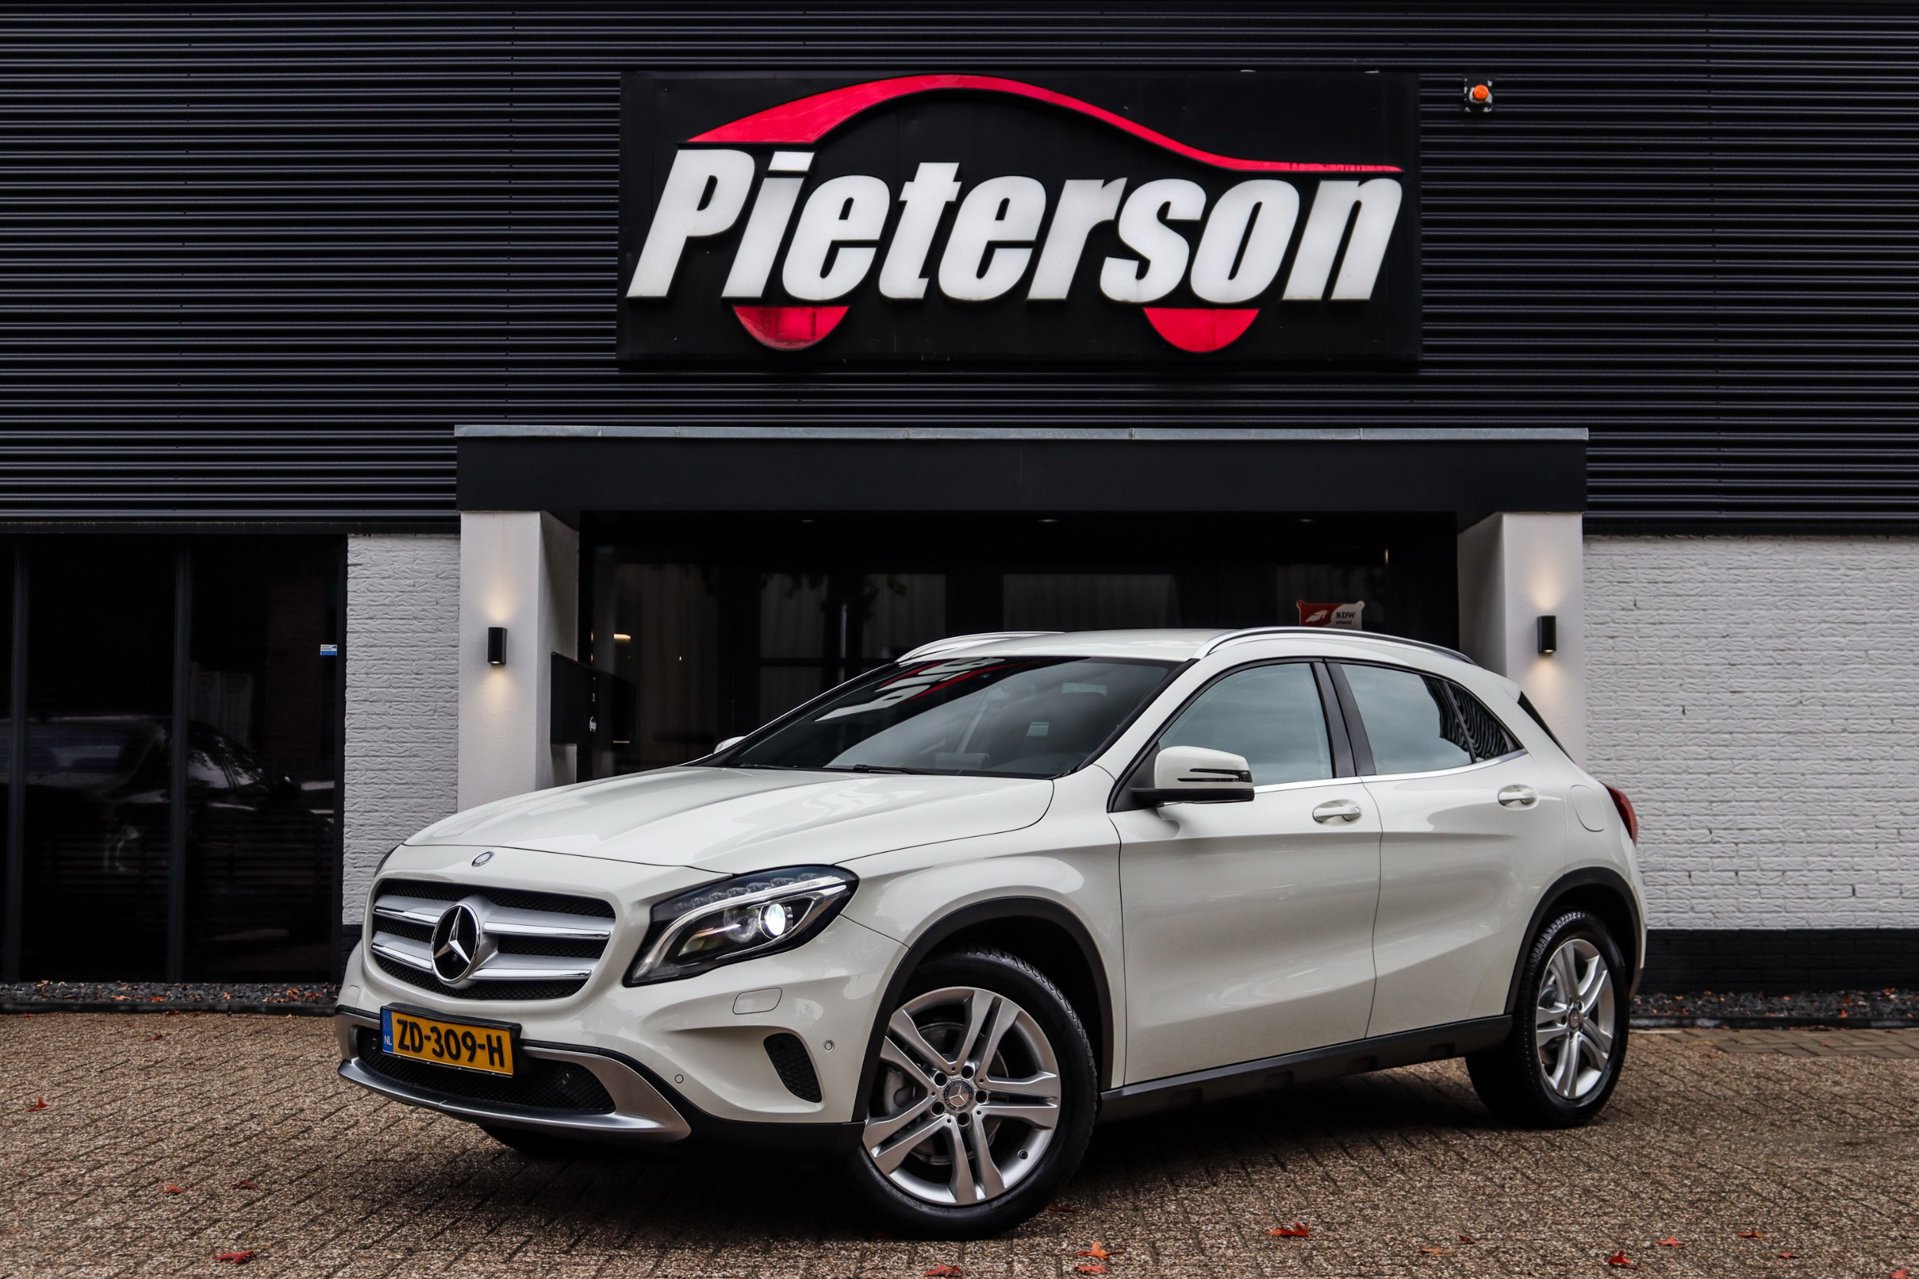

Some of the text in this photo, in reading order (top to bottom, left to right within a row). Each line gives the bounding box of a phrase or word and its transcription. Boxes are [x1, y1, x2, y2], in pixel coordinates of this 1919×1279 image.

[626, 149, 1402, 303] Pieterson
[384, 1034, 393, 1046] NL
[396, 1018, 505, 1067] ZD-309-H
